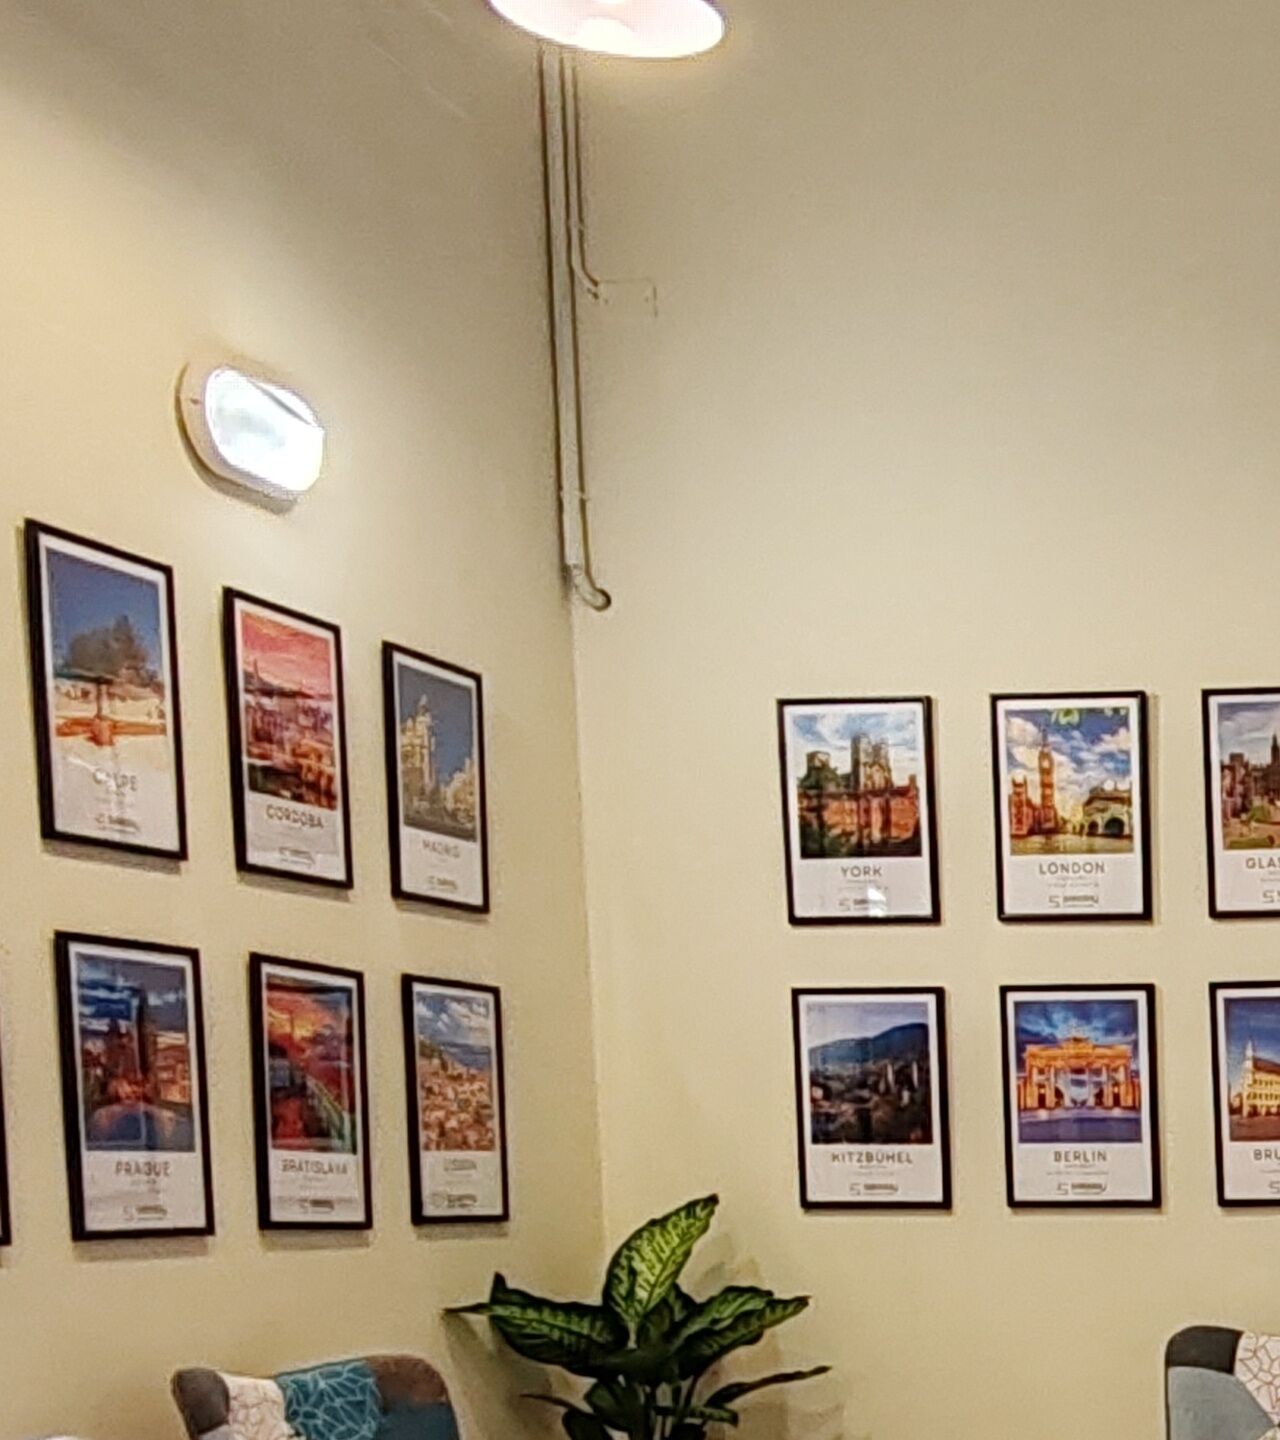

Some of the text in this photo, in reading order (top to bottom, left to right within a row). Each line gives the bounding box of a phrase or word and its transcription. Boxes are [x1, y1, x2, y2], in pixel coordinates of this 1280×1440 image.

[840, 865, 882, 878] YORK
[1038, 861, 1105, 875] LONDON
[1053, 1150, 1107, 1163] BERLIN
